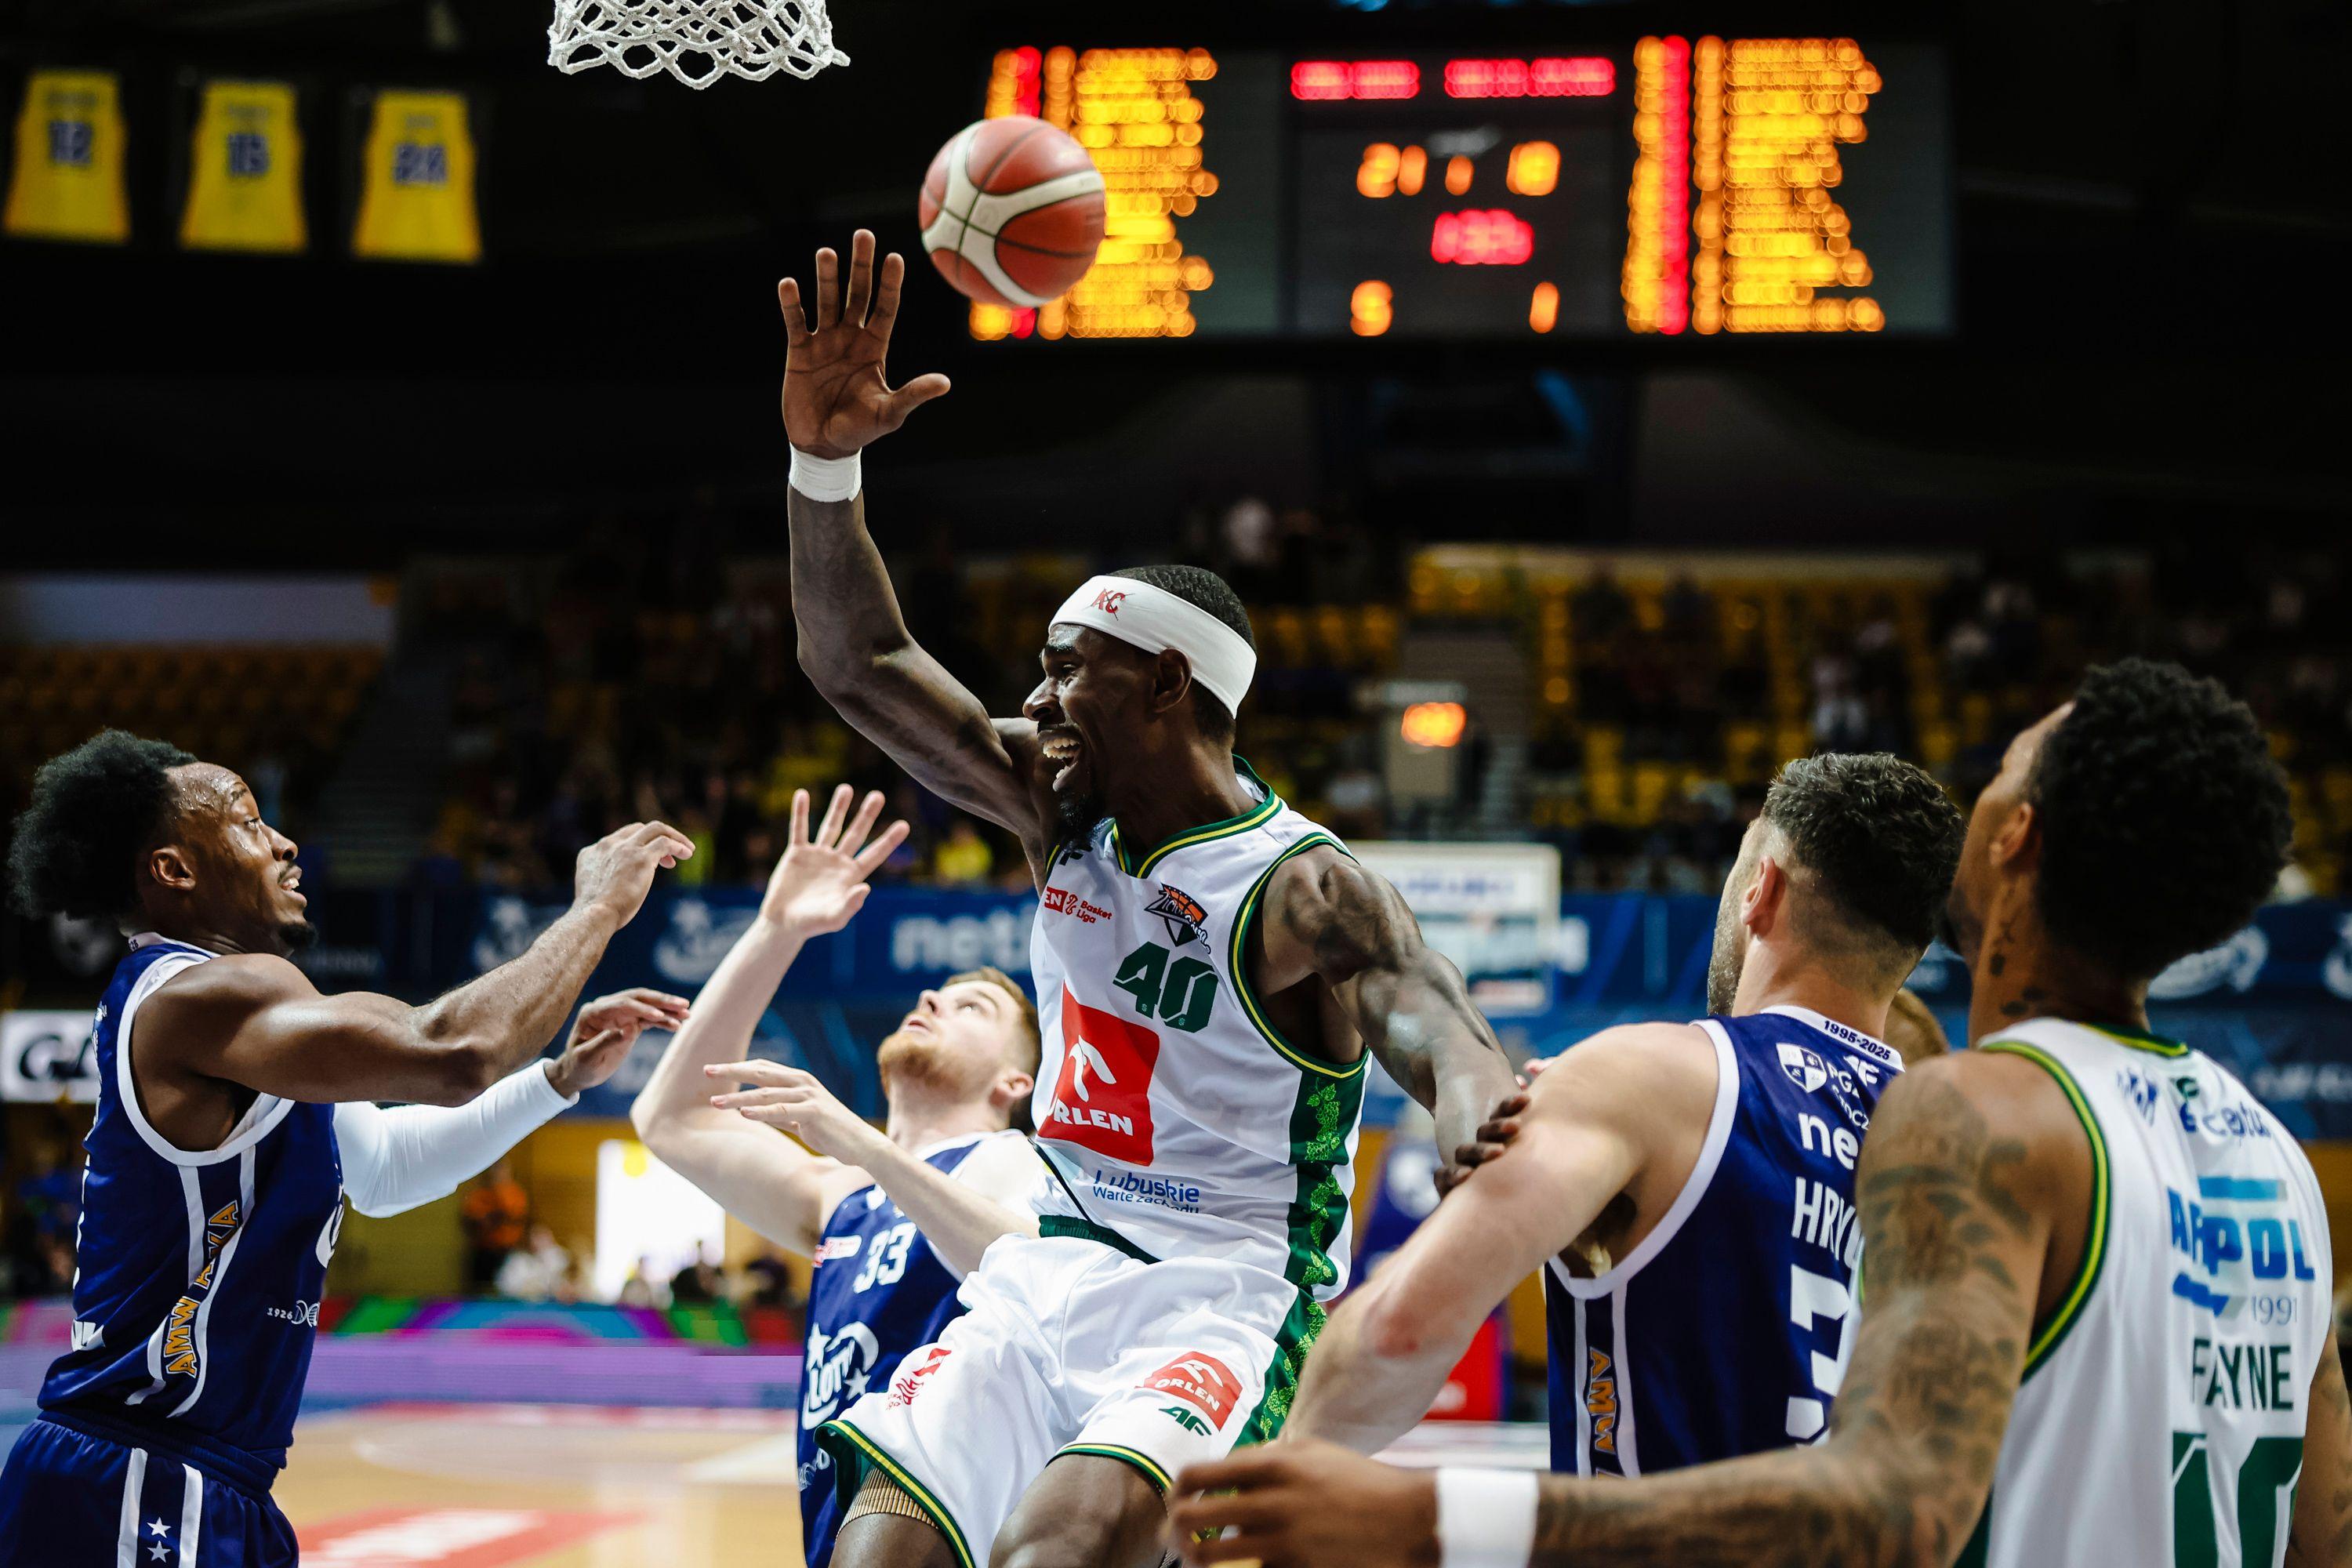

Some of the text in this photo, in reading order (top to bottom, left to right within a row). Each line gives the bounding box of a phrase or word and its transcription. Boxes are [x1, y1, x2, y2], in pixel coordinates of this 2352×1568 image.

[1076, 909, 1097, 924] Liga
[1080, 900, 1113, 921] Basket
[1112, 941, 1219, 1033] 40
[1824, 1020, 1892, 1060] 1995-2025
[1798, 1112, 1859, 1171] ne
[1093, 1185, 1134, 1202] Warte
[852, 1221, 918, 1294] 33
[267, 1307, 293, 1321] 1926
[2252, 1295, 2299, 1326] 1991
[162, 1295, 201, 1379] AMW
[1154, 1377, 1221, 1412] ORLEN
[2192, 1337, 2295, 1412] FAYNE
[1586, 1345, 1617, 1455] AMW
